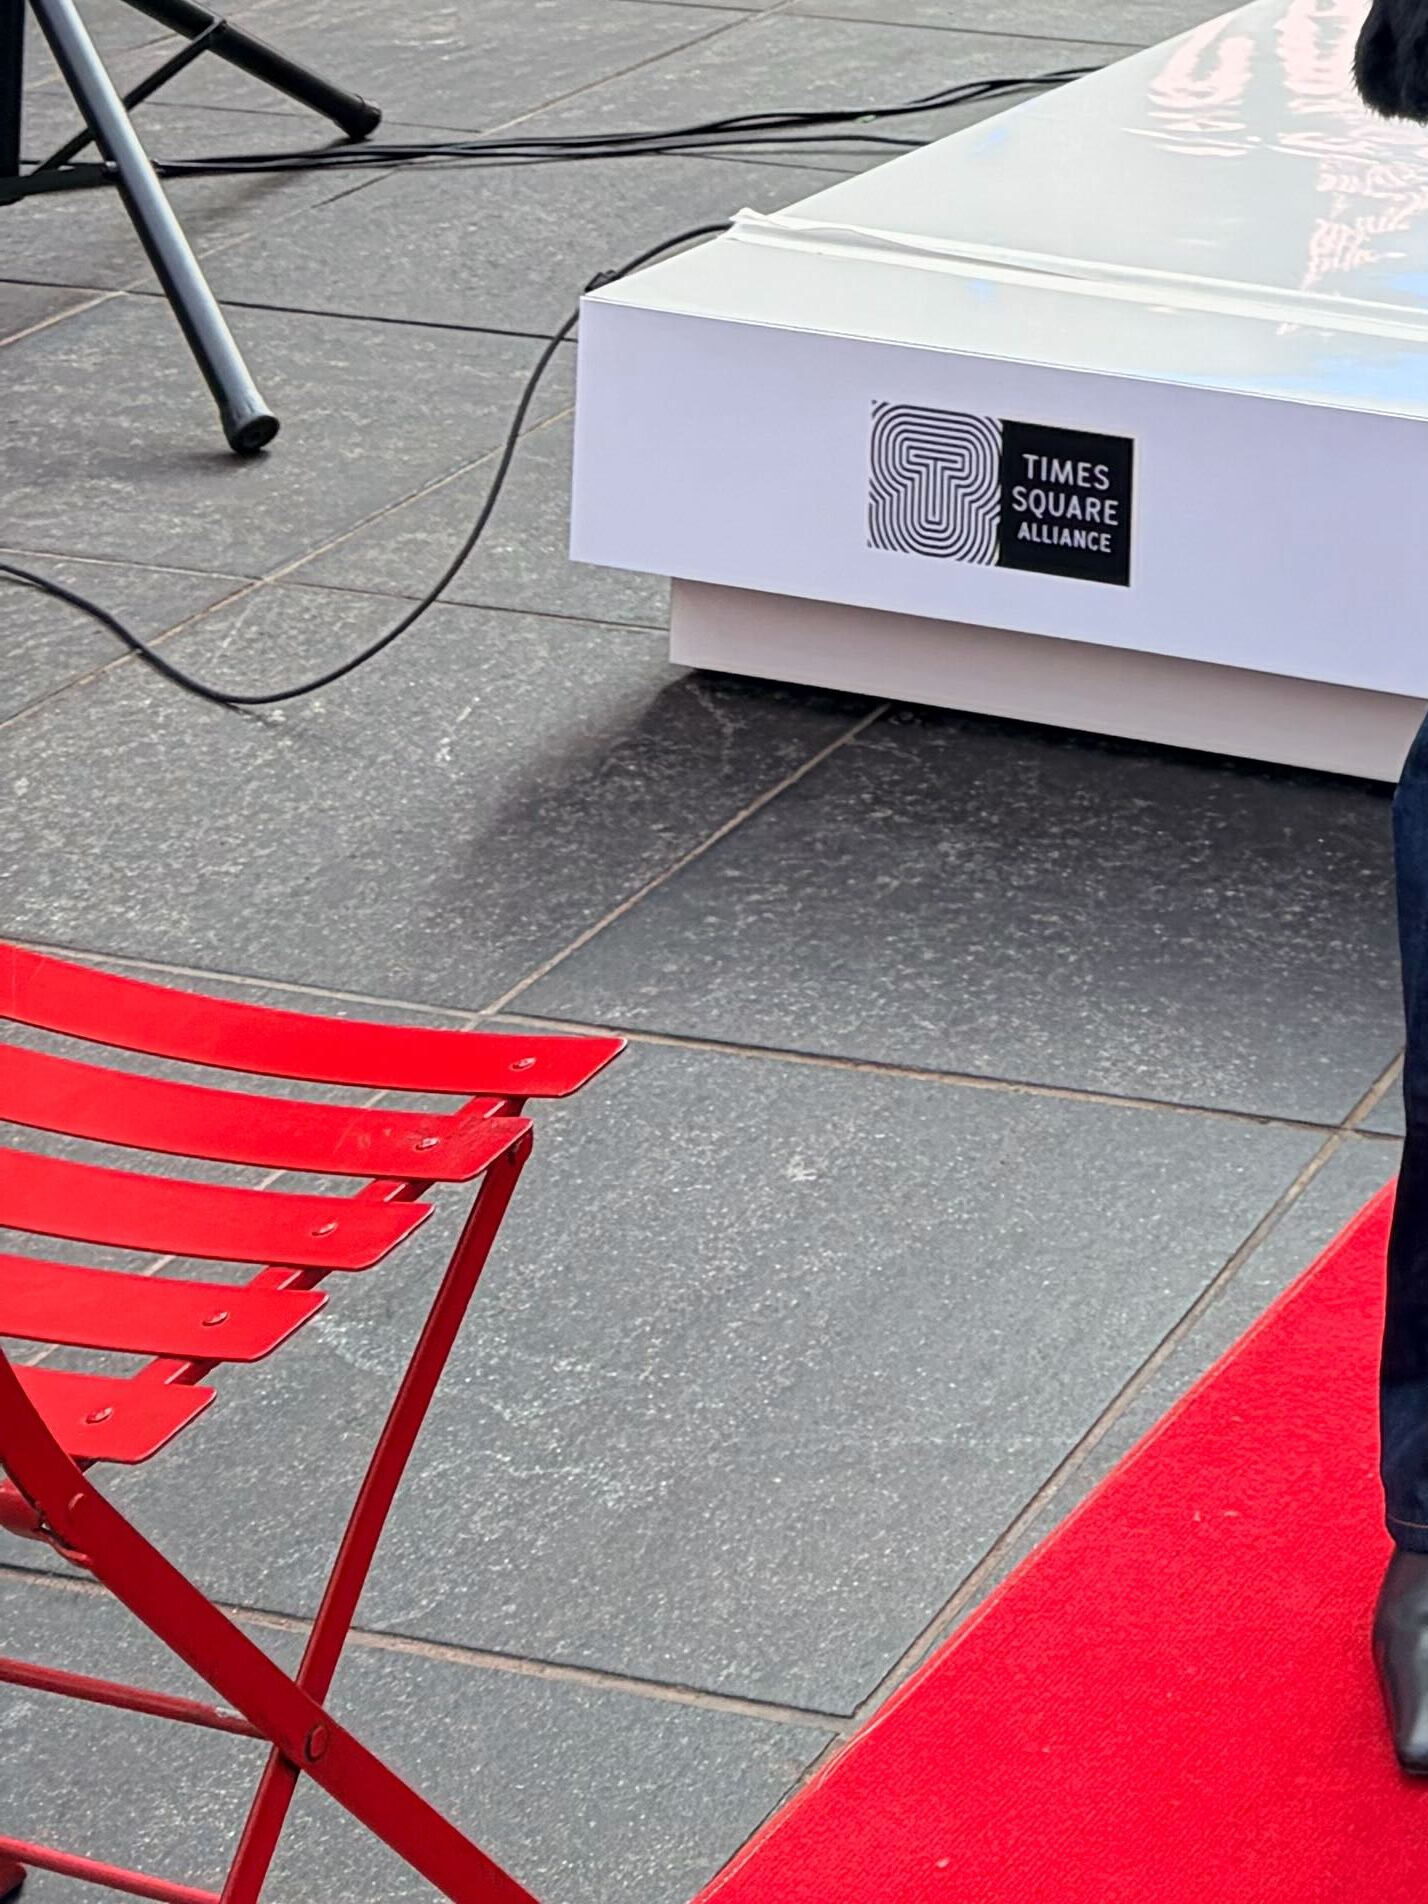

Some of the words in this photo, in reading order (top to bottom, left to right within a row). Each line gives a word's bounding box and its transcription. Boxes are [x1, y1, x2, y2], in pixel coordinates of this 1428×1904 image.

[1022, 452, 1111, 491] TIMES
[1010, 486, 1119, 527] SQUARE
[1016, 520, 1112, 554] ALLIANCE
